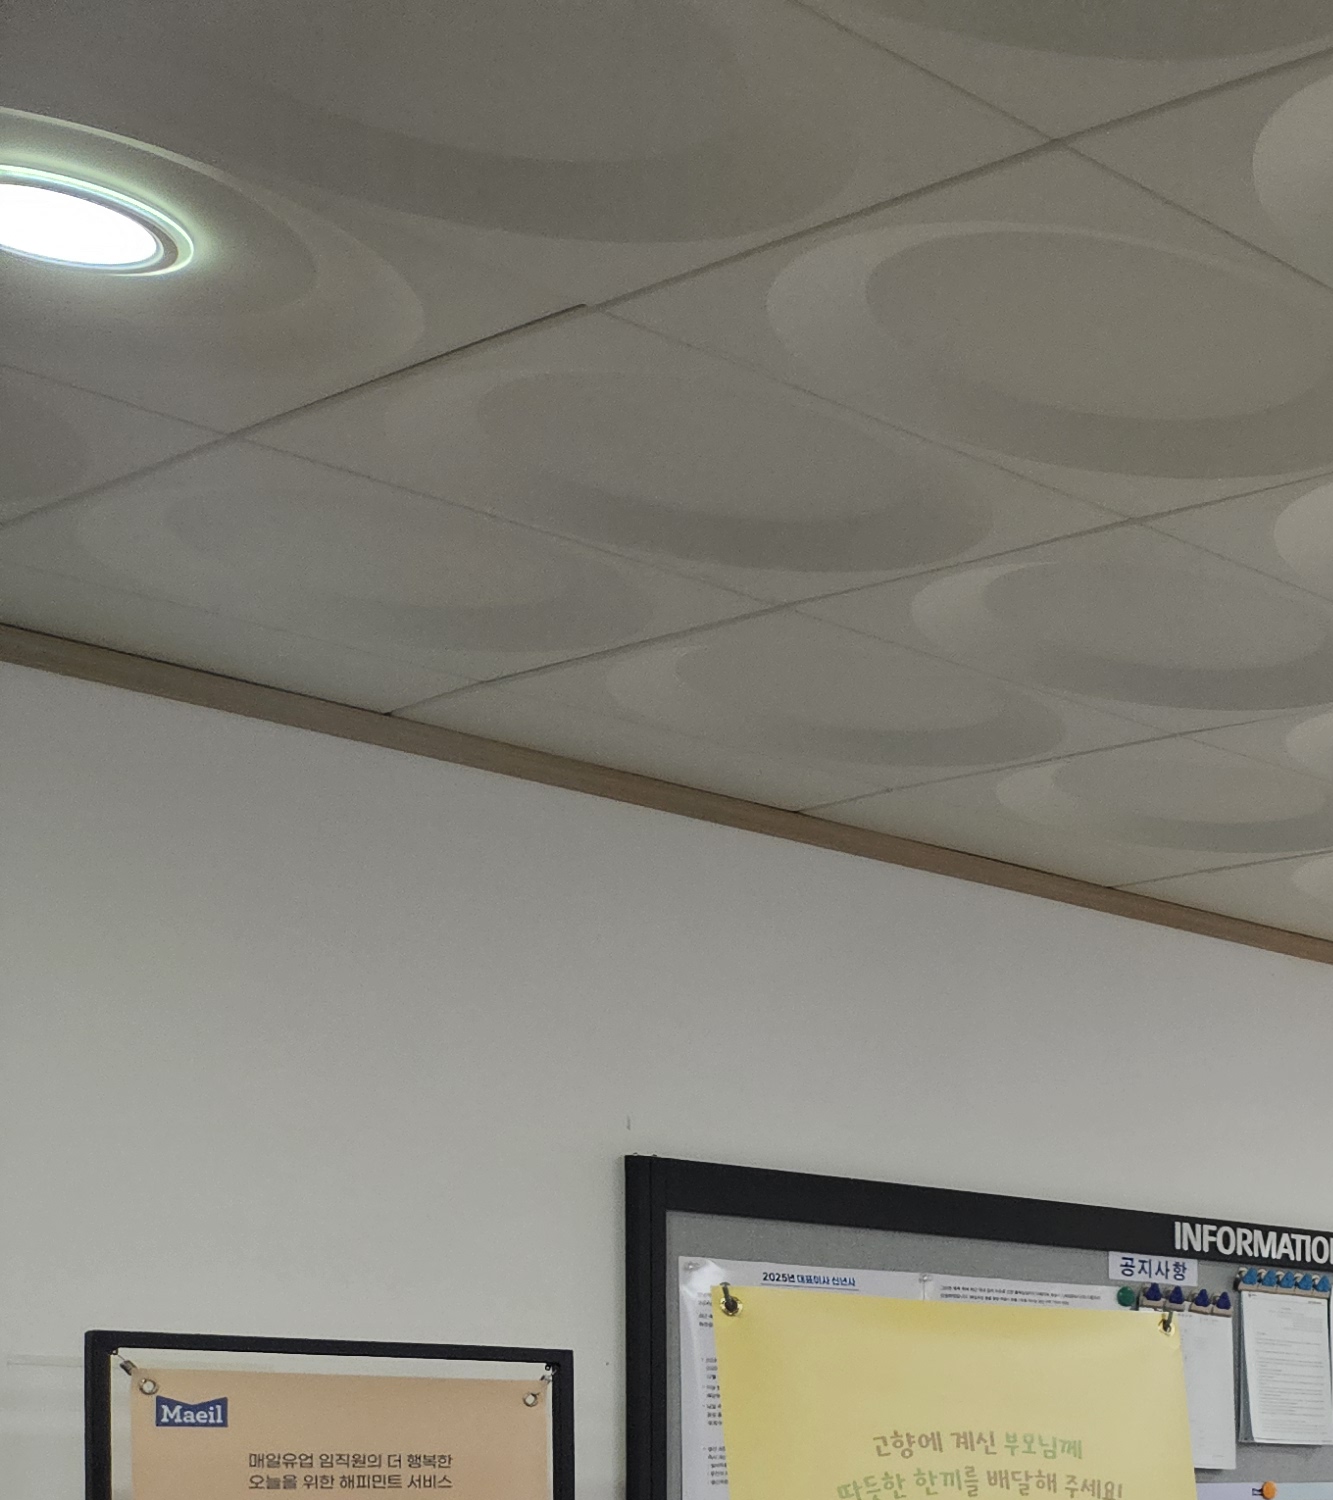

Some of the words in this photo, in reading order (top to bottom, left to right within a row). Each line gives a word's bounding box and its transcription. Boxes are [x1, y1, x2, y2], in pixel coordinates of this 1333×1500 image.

[762, 1272, 795, 1284] 2025년
[1120, 1257, 1187, 1281] 공지사항
[161, 1405, 223, 1424] Maeil
[872, 1430, 943, 1459] 고향에
[950, 1430, 998, 1456] 계신
[1003, 1432, 1083, 1459] 부모님께
[249, 1453, 313, 1469] 매일유업
[320, 1453, 381, 1469] 임직원의
[387, 1453, 402, 1469] 더
[408, 1453, 453, 1469] 행복한
[248, 1474, 297, 1490] 오늘을
[302, 1474, 335, 1490] 위한
[339, 1474, 403, 1490] 해피민트
[407, 1474, 453, 1490] 서비스
[914, 1466, 980, 1497] 한끼를
[987, 1469, 1058, 1496] 배달해
